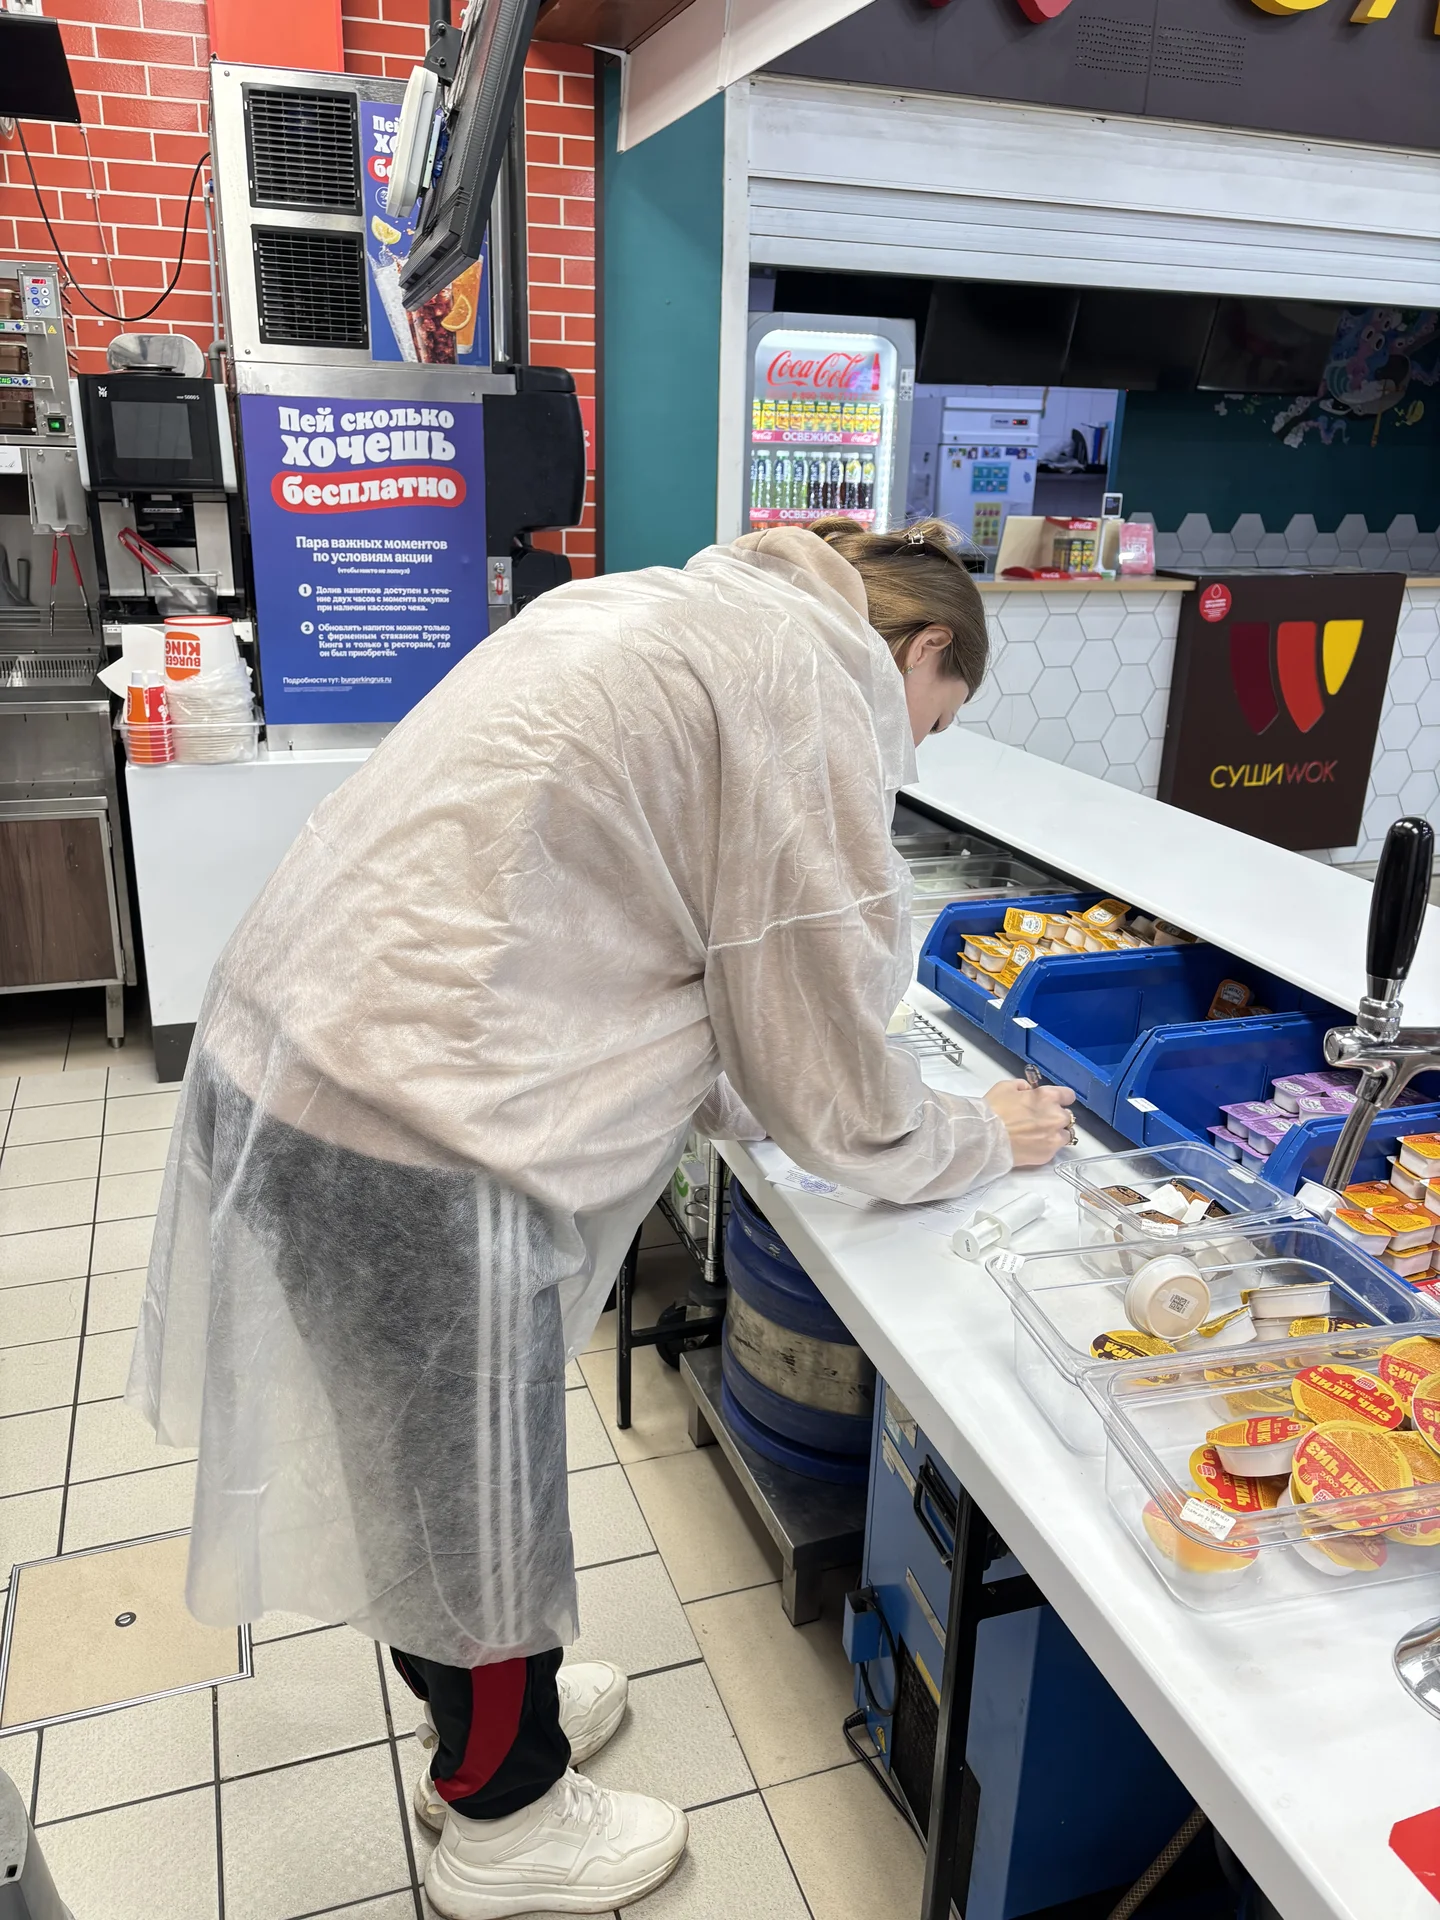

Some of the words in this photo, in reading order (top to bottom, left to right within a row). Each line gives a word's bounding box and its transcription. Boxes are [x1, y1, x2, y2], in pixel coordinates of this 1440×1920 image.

[766, 350, 867, 389] Coca-Cola
[278, 406, 334, 433] Пей
[340, 408, 455, 432] сколько
[782, 431, 843, 443] ОСВЕЖИСЬ!
[280, 430, 456, 468] хочешь
[282, 474, 457, 506] бесплатно
[295, 536, 330, 551] Пара
[330, 538, 383, 549] важных
[383, 539, 448, 550] моментов
[313, 552, 330, 562] по
[330, 552, 393, 564] условиям
[394, 553, 433, 564] акции
[316, 586, 342, 595] Долив
[343, 587, 382, 595] напитков
[383, 587, 422, 596] доступен
[332, 596, 352, 605] двух
[417, 597, 450, 605] покупки
[317, 604, 332, 613] при
[318, 623, 362, 632] Обновлять
[423, 624, 451, 632] только
[327, 632, 377, 642] фирменным
[422, 632, 451, 642] Бургер
[165, 640, 201, 657] KING
[319, 640, 343, 649] Кинга
[391, 641, 436, 651] ресторане,
[437, 642, 451, 650] где
[330, 648, 348, 657] был
[348, 648, 398, 659] приобретён.
[283, 676, 328, 685] Подробности
[1309, 1371, 1357, 1400] ЧИЛИ
[1357, 1398, 1393, 1422] ЧИЗ
[1305, 1441, 1339, 1476] ЧИЗ
